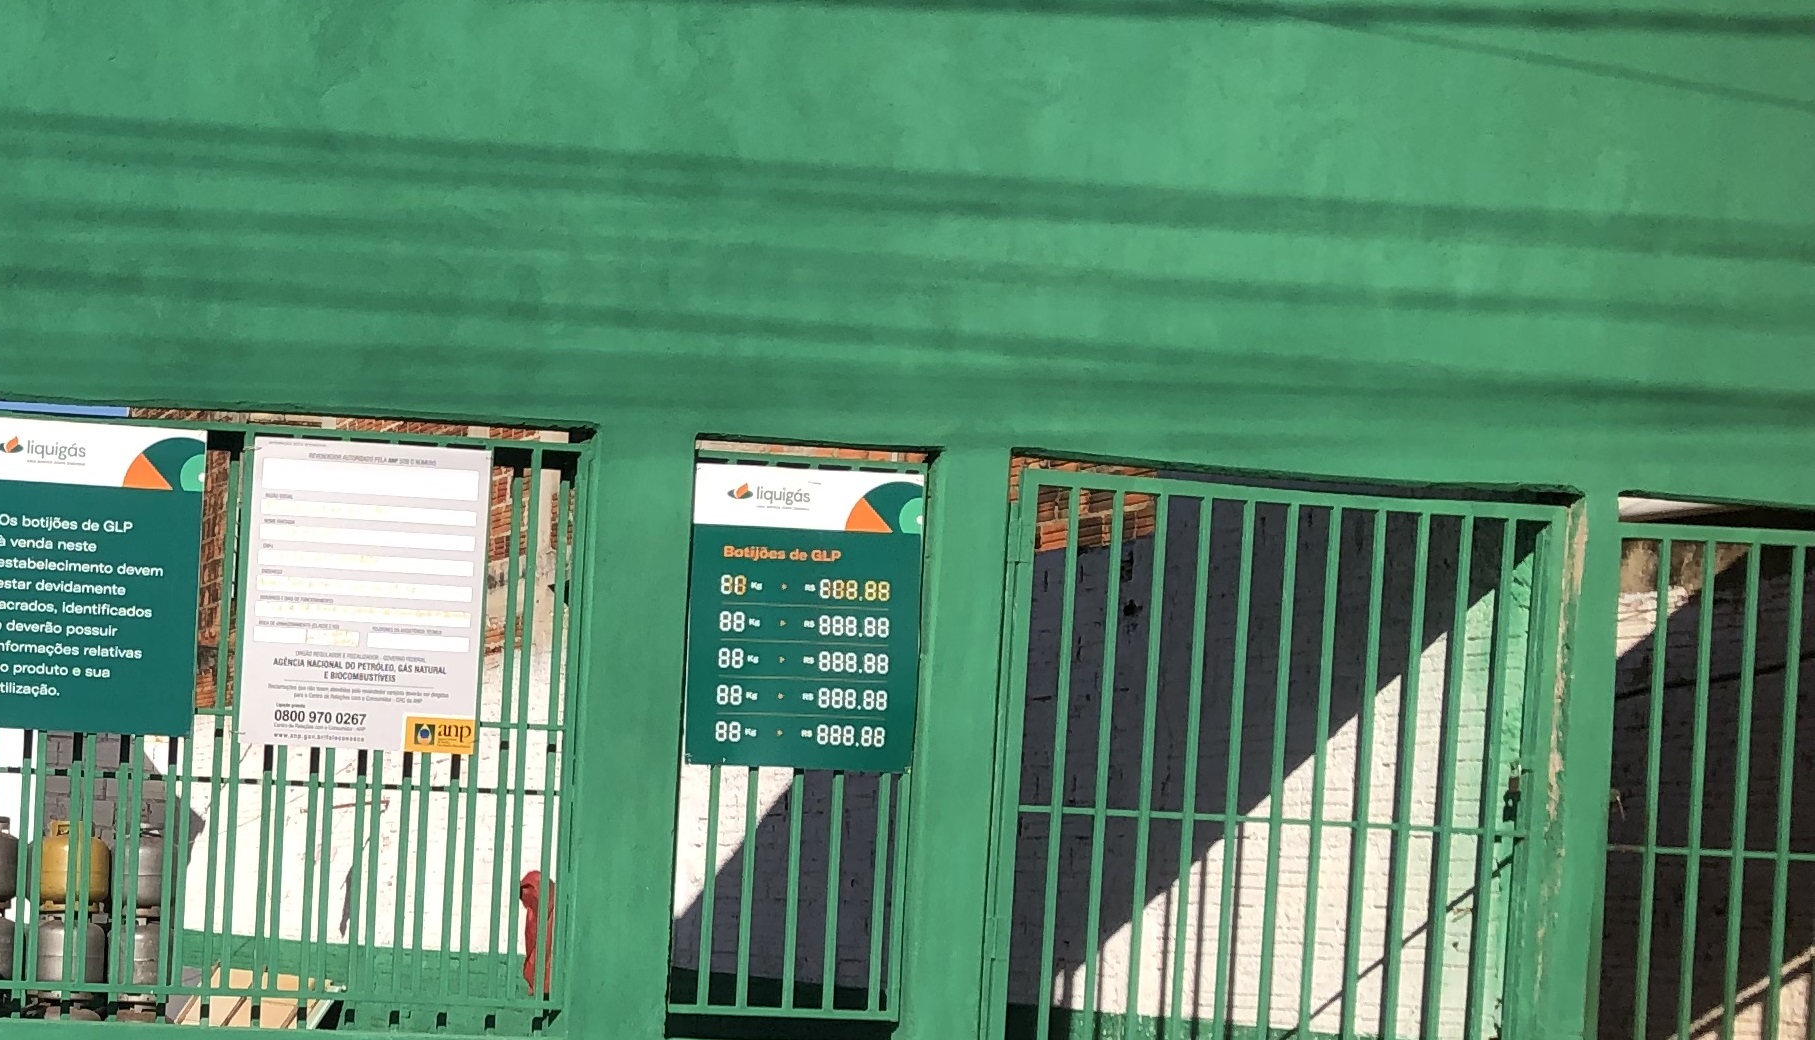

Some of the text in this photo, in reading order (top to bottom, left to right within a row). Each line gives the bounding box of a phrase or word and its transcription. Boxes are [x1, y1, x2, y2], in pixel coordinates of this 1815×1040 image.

[27, 440, 86, 459] liquigás
[756, 486, 810, 505] liquigás
[22, 515, 77, 532] botijões
[82, 520, 99, 531] de
[103, 520, 132, 533] GLP
[10, 537, 52, 549] venda
[58, 540, 96, 552] neste
[723, 546, 841, 562] Botijões de GLP
[117, 564, 163, 576] devem
[36, 580, 126, 595] devidamente
[751, 581, 762, 591] Kg
[62, 602, 152, 618] identificados
[6, 620, 62, 634] deverão
[66, 625, 117, 639] possuir
[749, 618, 760, 628] Kg
[84, 645, 142, 659] relativas
[747, 655, 759, 664] Kg
[13, 663, 68, 678] produto
[72, 667, 81, 676] e
[85, 668, 110, 678] sua
[273, 657, 304, 667] AGÊNCIA
[307, 660, 342, 669] NACIONAL
[345, 661, 355, 669] DO
[398, 663, 412, 672] GÁS
[415, 665, 446, 674] NATURAL
[331, 672, 396, 682] BIOCOMBUSTÍVEIS
[746, 692, 757, 701] Kg
[275, 709, 366, 725] 0800 970 0267
[438, 724, 471, 742] anp
[745, 728, 756, 737] Kg
